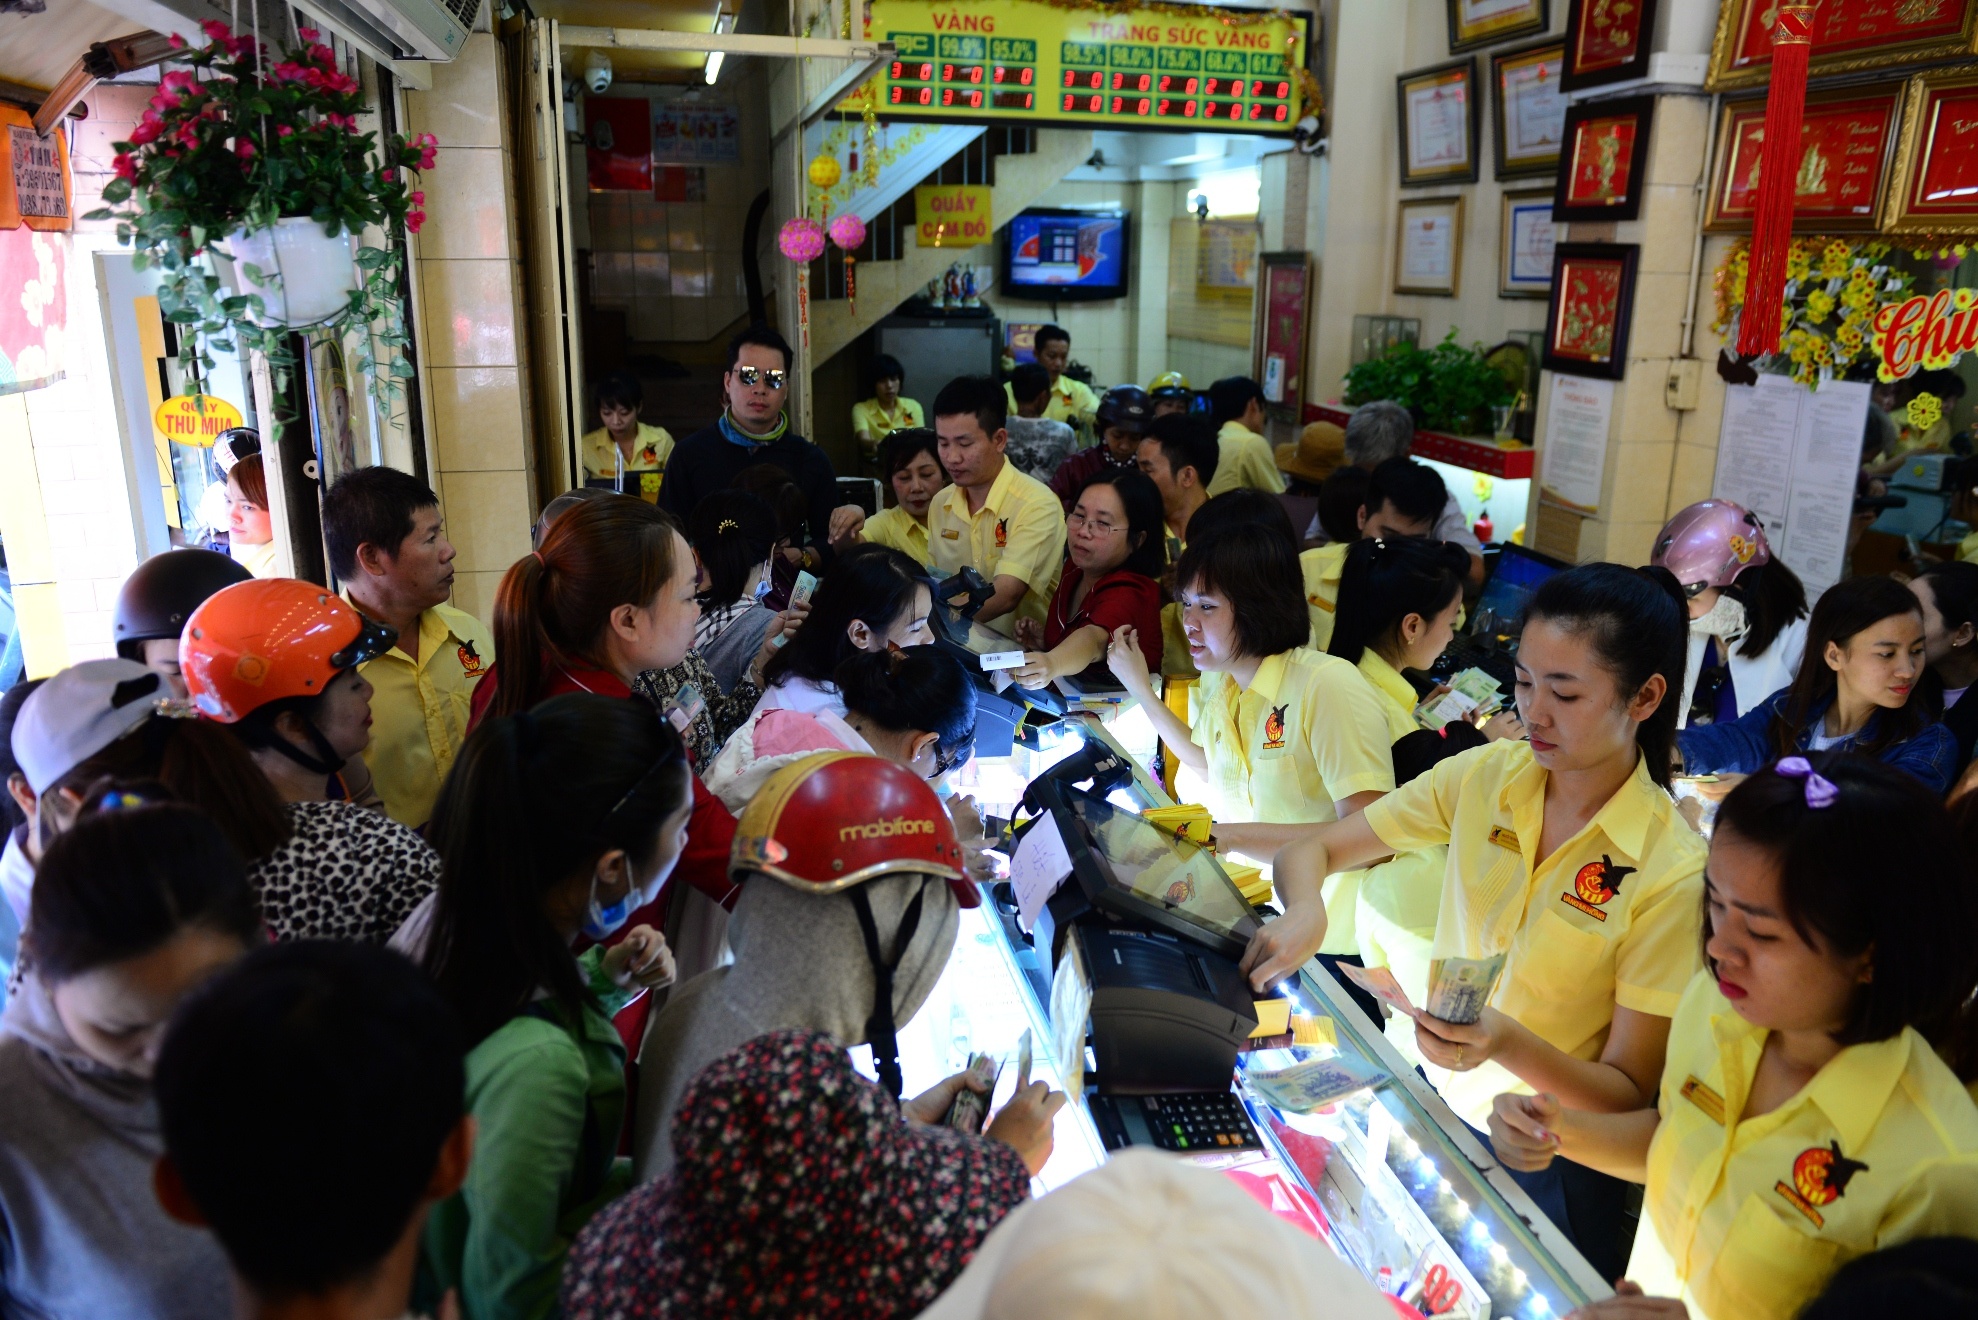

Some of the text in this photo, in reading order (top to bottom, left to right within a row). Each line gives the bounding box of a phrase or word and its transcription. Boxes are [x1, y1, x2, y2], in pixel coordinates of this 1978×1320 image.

[932, 9, 995, 33] VÀNG
[1088, 22, 1271, 49] TRANG SỨC VÀNG
[941, 36, 984, 57] 99.9%
[992, 39, 1034, 61] 95.0%
[1160, 48, 1199, 69] 75.0%
[165, 414, 195, 435] THU
[839, 816, 935, 842] mobifone
